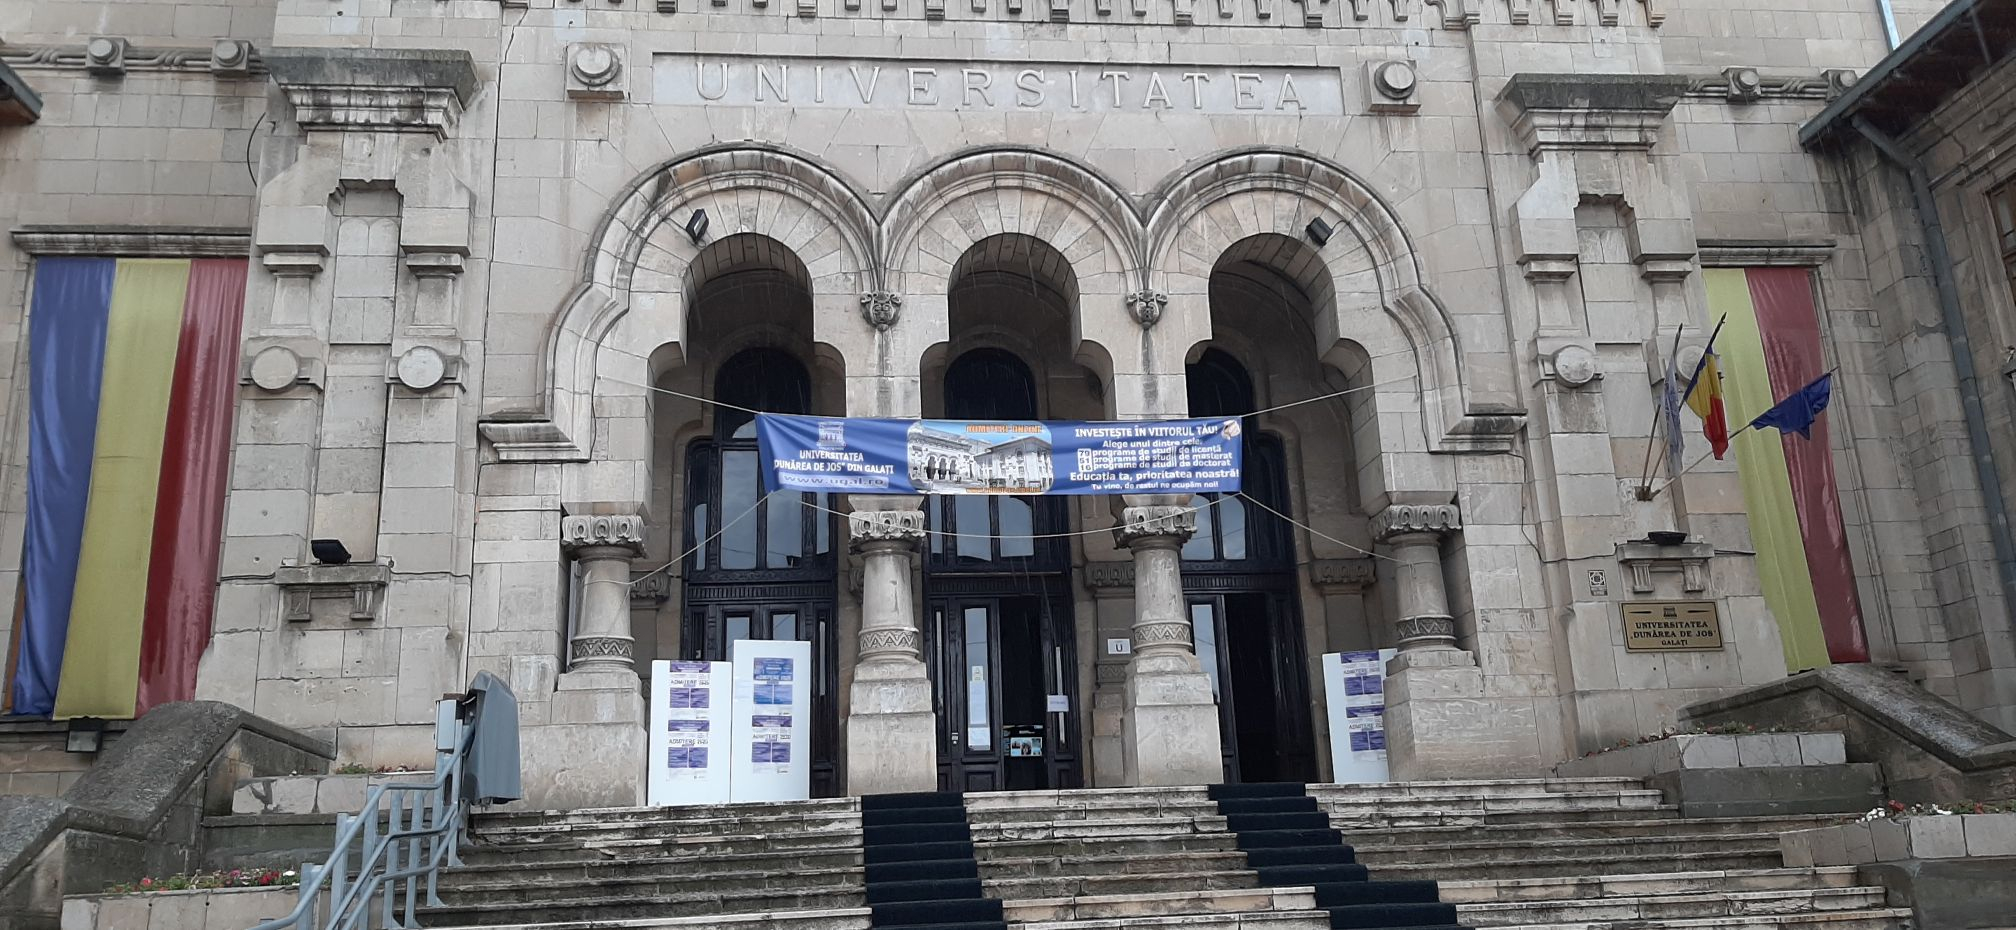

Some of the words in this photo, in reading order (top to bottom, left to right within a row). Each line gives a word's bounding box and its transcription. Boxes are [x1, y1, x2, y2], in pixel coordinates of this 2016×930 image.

[694, 60, 1307, 110] UNIVERSITATEA
[1134, 425, 1146, 436] ÎN
[1148, 426, 1194, 436] VIITORUL
[1196, 424, 1218, 434] TĂU!
[1102, 440, 1128, 449] Alege
[1152, 439, 1180, 447] dintre
[1152, 446, 1176, 454] studii
[800, 450, 864, 462] UNIVERSITATEA
[1093, 456, 1137, 464] programe
[814, 462, 824, 471] DE
[847, 463, 862, 472] DIN
[1094, 462, 1138, 470] programe
[1118, 472, 1132, 481] ta,
[1136, 470, 1192, 480] prioritatea
[1195, 468, 1240, 478] noastră!
[1635, 621, 1708, 629] UNIVERSITATEA
[1116, 643, 1122, 652] U
